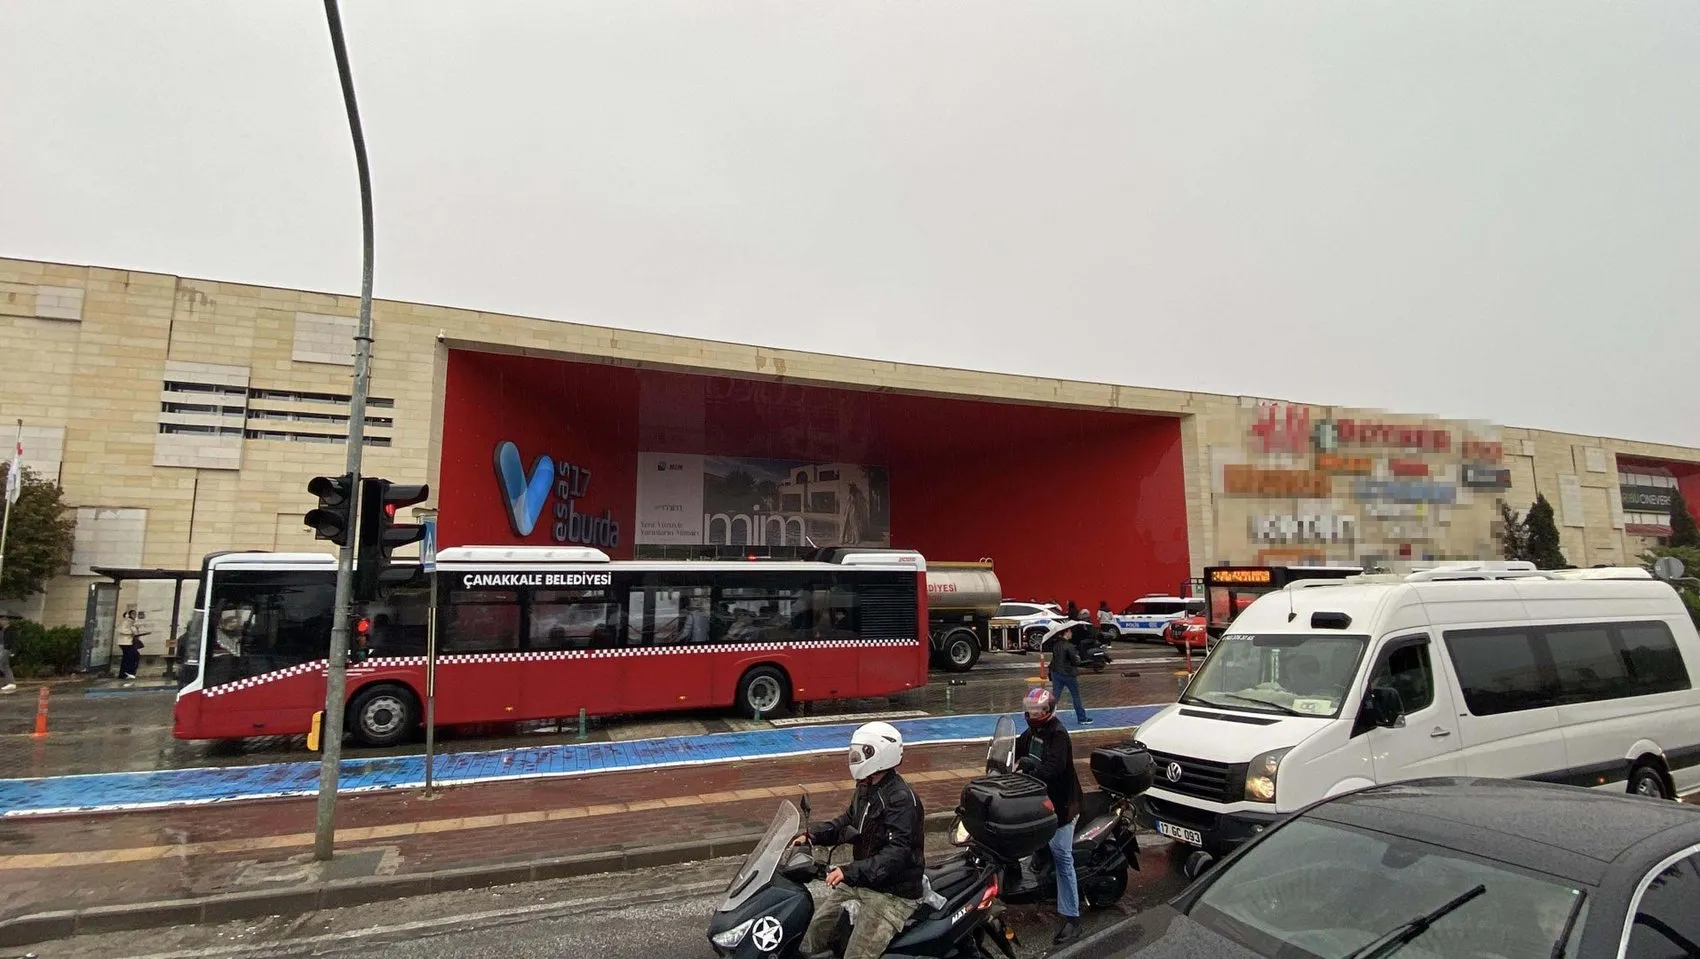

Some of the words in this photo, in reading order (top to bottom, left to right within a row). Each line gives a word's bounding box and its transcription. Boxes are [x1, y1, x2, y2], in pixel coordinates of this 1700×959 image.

[570, 465, 592, 498] 17
[568, 499, 619, 547] burda
[704, 503, 806, 546] mim
[463, 574, 543, 589] ÇANAKKALE
[545, 571, 612, 586] BELEDİYESİ
[1161, 823, 1169, 834] 17
[1184, 830, 1201, 842] 093
